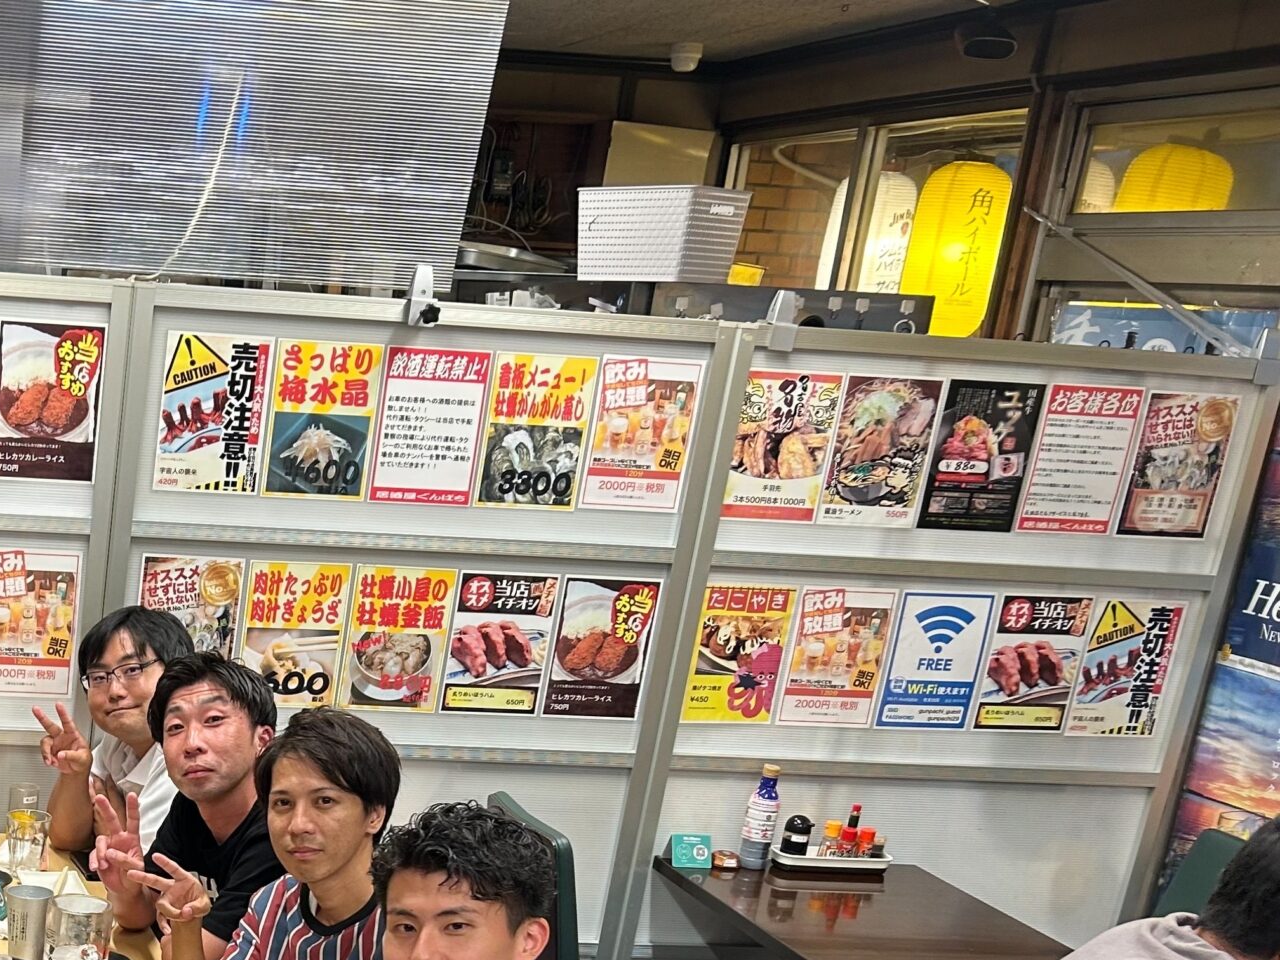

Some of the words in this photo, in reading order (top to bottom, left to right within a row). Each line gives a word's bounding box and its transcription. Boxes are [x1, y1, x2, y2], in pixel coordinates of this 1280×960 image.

[949, 187, 995, 298] 角ハイボール
[283, 344, 373, 375] さっぱり
[173, 362, 217, 385] CAUTION
[278, 374, 369, 407] 梅水晶
[1025, 389, 1037, 415] 国産牛
[1050, 390, 1140, 415] お客様各位
[1150, 402, 1200, 420] オススメ
[994, 390, 1024, 443] ユッケ
[1147, 417, 1195, 434] せずには
[0, 452, 65, 463] ヒレカツカレーライス
[663, 448, 681, 460] 当日
[158, 478, 178, 486] 420円
[824, 508, 862, 516] 醤油ラーメン
[885, 510, 908, 519] 550円
[147, 564, 200, 584] オススメ
[253, 570, 343, 596] 肉汁たっぷり
[147, 580, 197, 597] せずには
[359, 574, 448, 602] 牡蠣小屋の
[495, 579, 529, 597] 当店
[493, 597, 539, 611] イチオシ
[710, 592, 786, 608] たこやき
[250, 596, 342, 624] 肉汁ぎょうざ
[357, 602, 445, 630] 牡蠣釜飯
[1033, 601, 1067, 619] 当店
[1031, 618, 1073, 631] イチオシ
[49, 637, 69, 649] 当日
[1096, 624, 1135, 645] CAUTION
[917, 658, 952, 672] FREE
[856, 669, 875, 680] 当日
[551, 693, 612, 702] ヒレカツカレーライス
[550, 703, 569, 711] 750円
